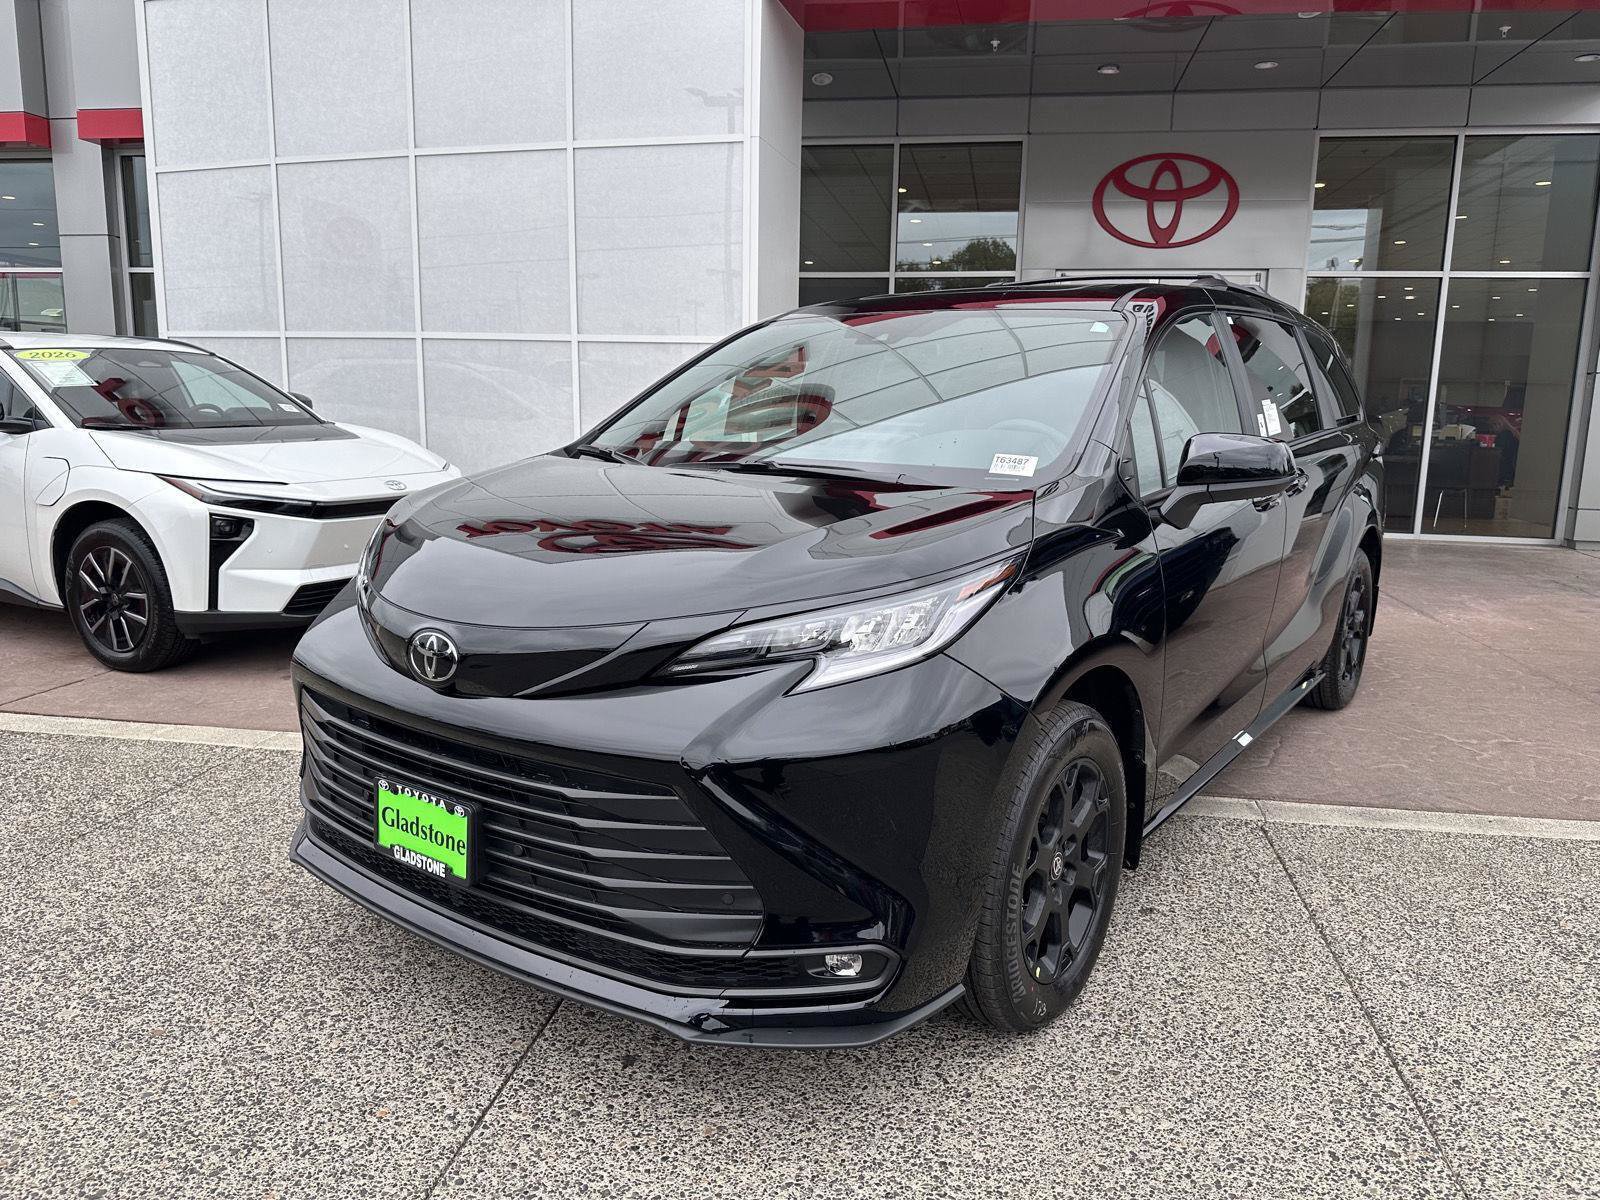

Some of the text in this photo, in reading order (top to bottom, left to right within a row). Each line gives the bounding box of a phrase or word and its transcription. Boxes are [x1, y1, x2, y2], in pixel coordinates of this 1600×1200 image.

[29, 351, 76, 359] 2026
[995, 456, 1029, 465] T63487
[396, 784, 447, 810] TOYOTA
[381, 806, 466, 856] Gladstone
[393, 845, 446, 878] GLADSTONE
